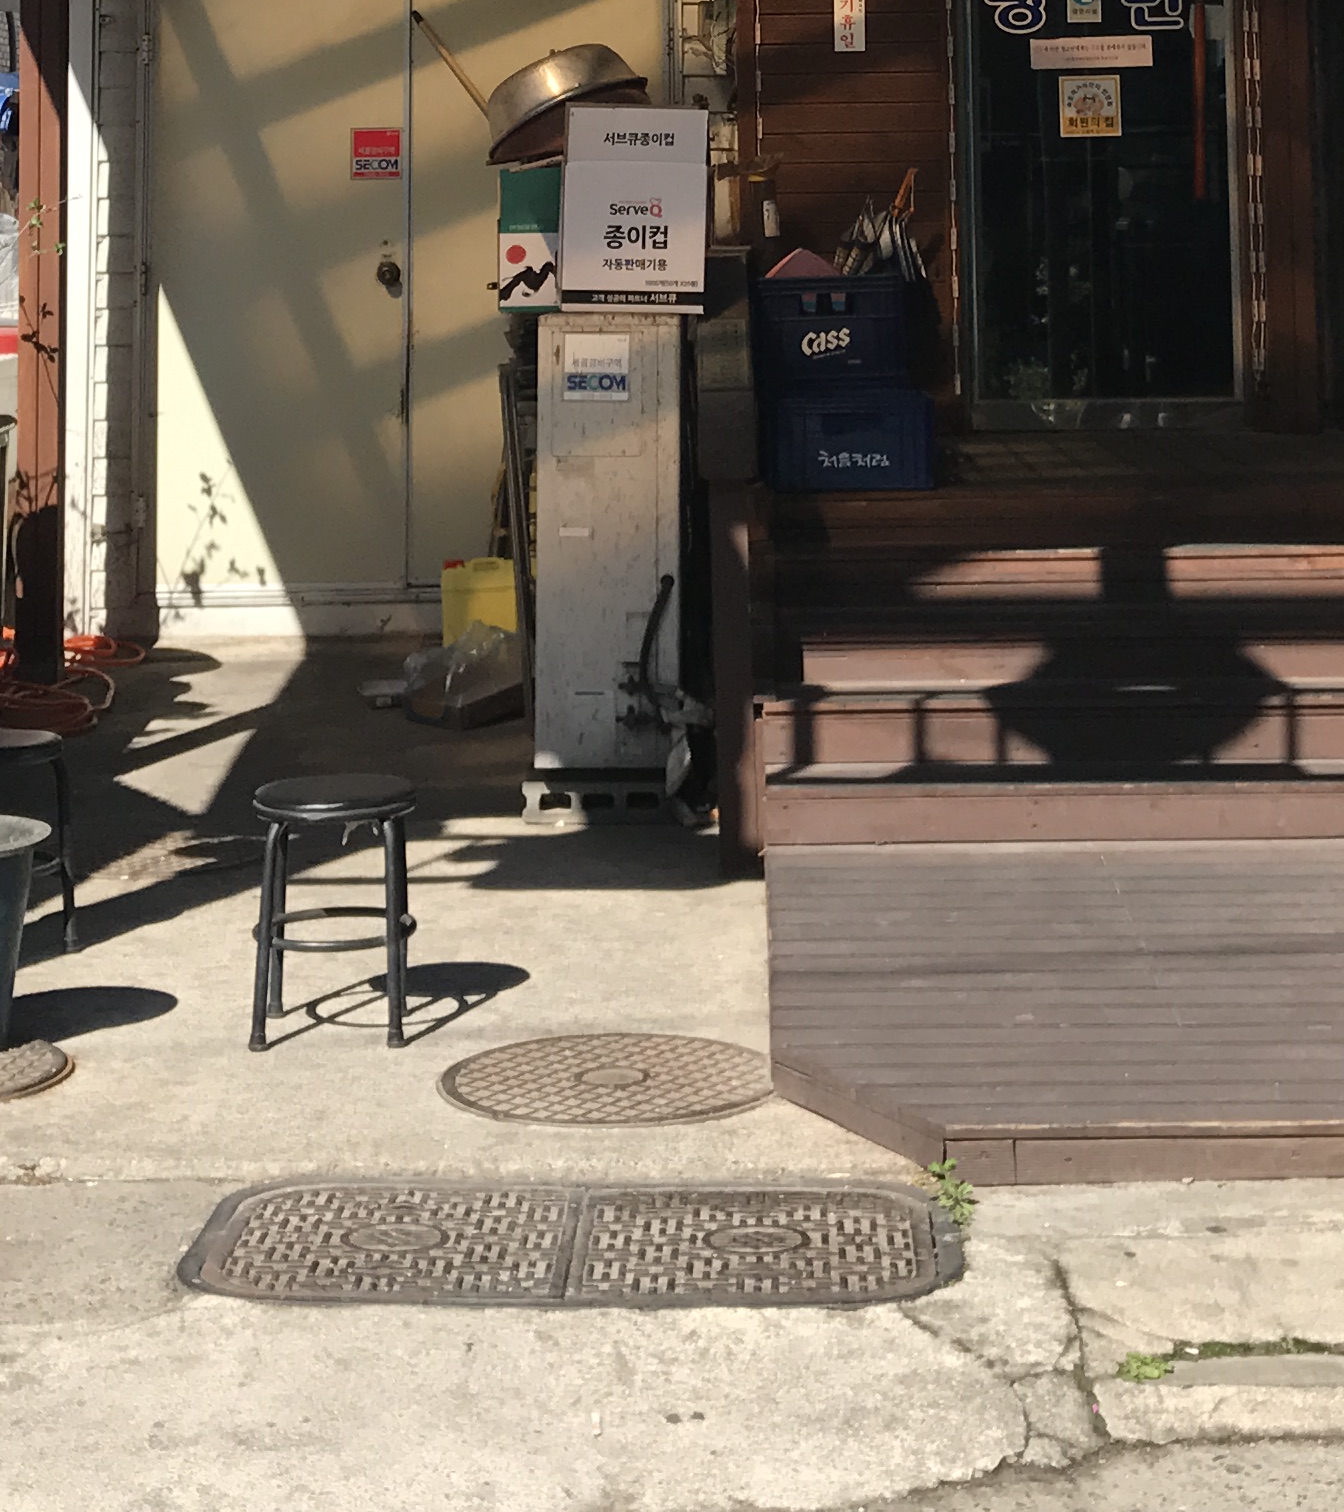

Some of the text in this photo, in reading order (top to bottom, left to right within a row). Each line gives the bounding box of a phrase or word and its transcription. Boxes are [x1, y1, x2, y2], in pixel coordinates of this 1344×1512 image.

[603, 132, 676, 147] 서브큐종이컵
[354, 158, 399, 171] SECOM
[603, 224, 669, 250] 종이컵
[602, 258, 668, 271] 자동판매기용
[649, 292, 677, 304] 서브큐
[801, 327, 851, 356] Cass
[566, 374, 627, 391] SECOM
[817, 450, 890, 468] 처음처럼
